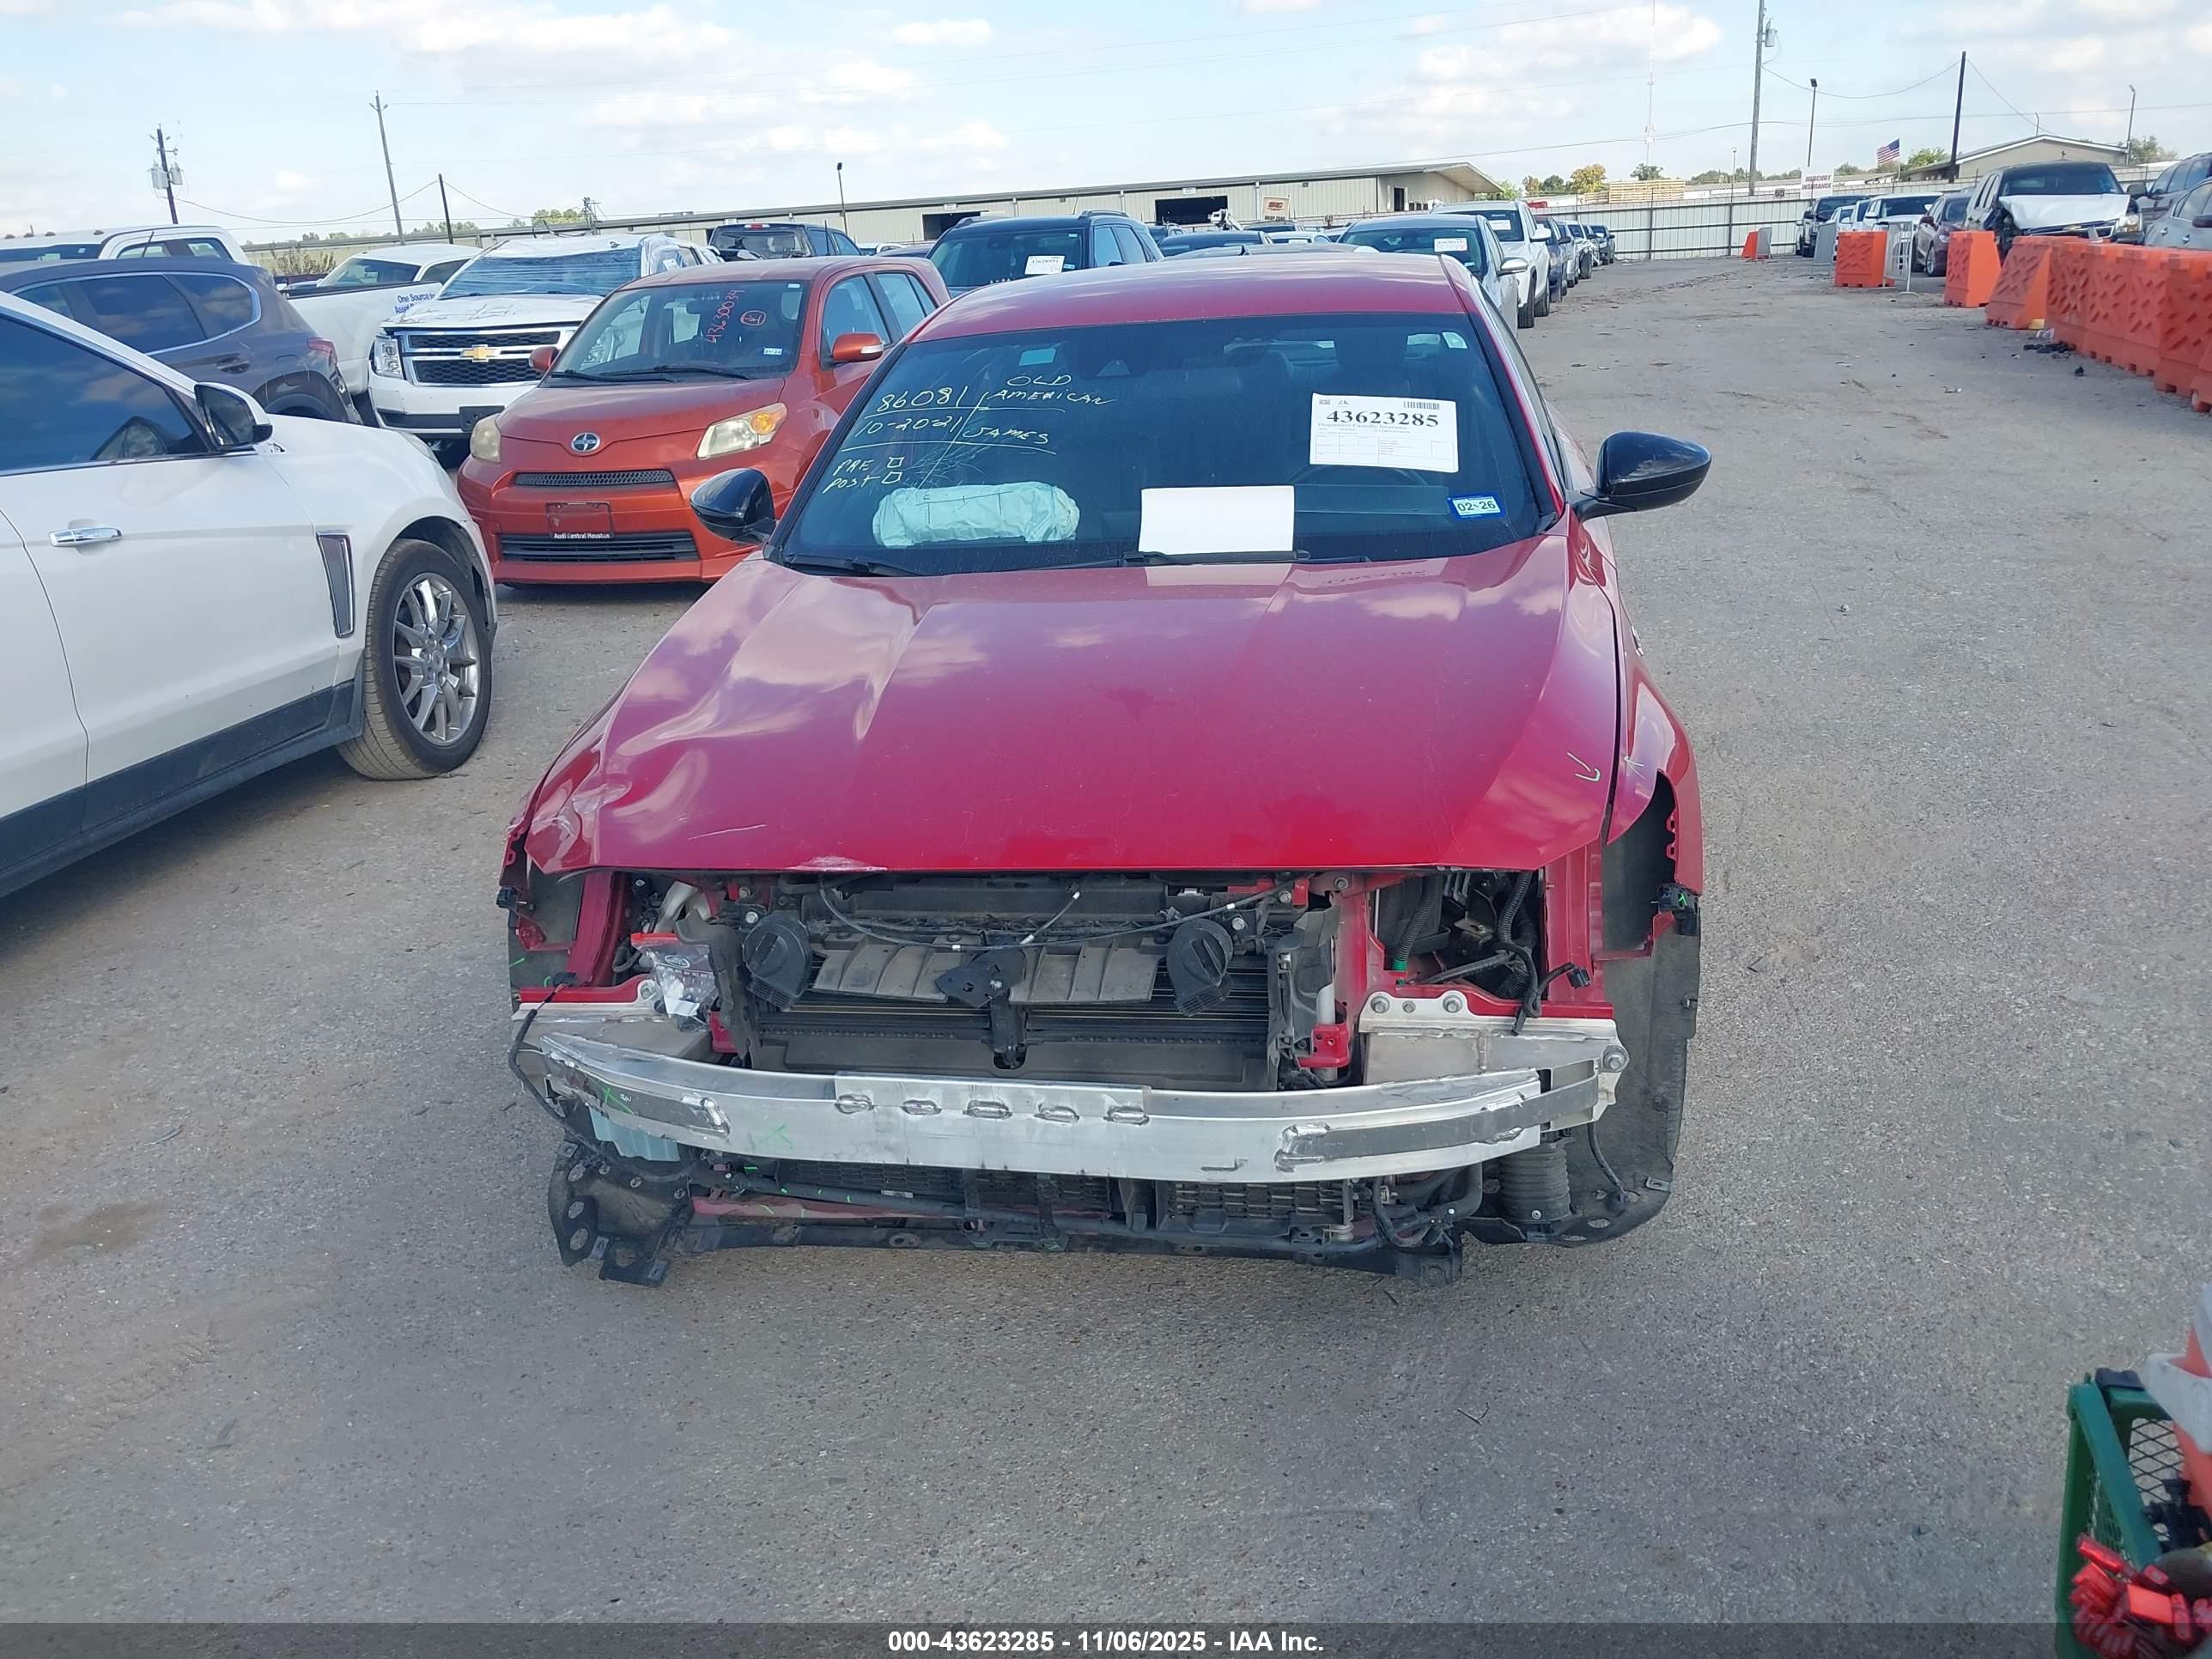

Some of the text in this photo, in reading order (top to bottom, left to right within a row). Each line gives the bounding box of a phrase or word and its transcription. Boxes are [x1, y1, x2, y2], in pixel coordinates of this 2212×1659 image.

[410, 293, 429, 301] Source
[1007, 374, 1072, 386] OLD
[877, 386, 968, 413] 86081
[988, 389, 1117, 405] AMERICAN
[1326, 410, 1439, 428] 43623285
[963, 427, 1049, 444] JAMES
[833, 459, 875, 476] PRE
